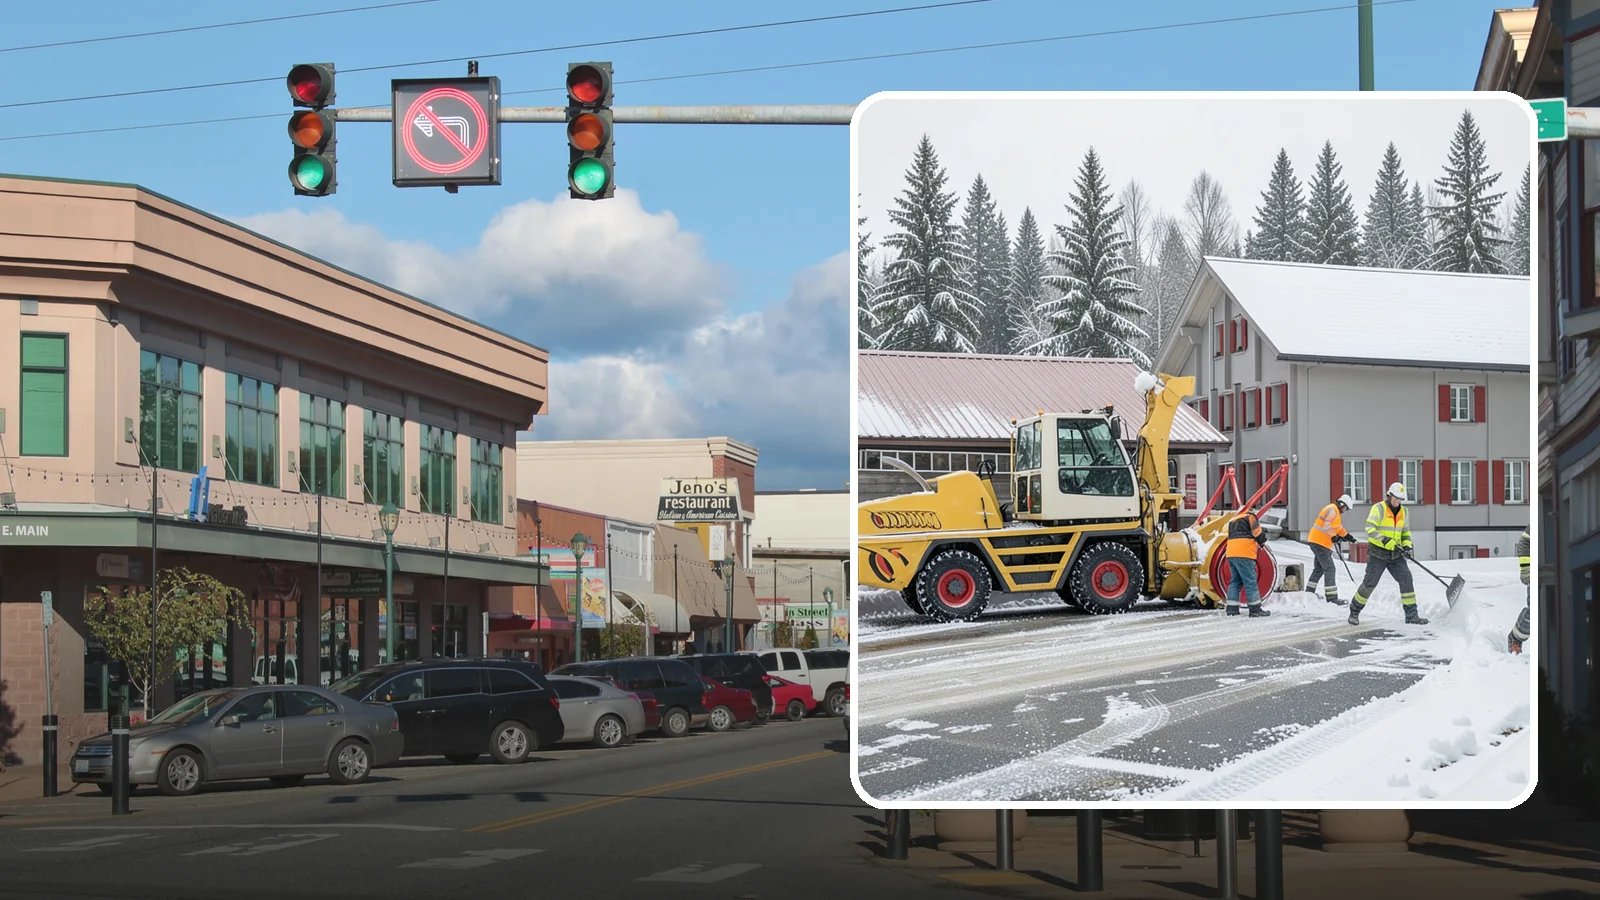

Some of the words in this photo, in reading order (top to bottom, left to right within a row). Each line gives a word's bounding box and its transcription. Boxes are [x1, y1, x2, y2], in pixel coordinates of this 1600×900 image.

[669, 479, 728, 495] Jeno's
[664, 496, 731, 509] restaurant
[685, 509, 714, 519] American
[714, 509, 738, 519] Cuisine
[2, 525, 13, 536] E.
[15, 525, 49, 536] MAIN
[797, 606, 829, 617] Street
